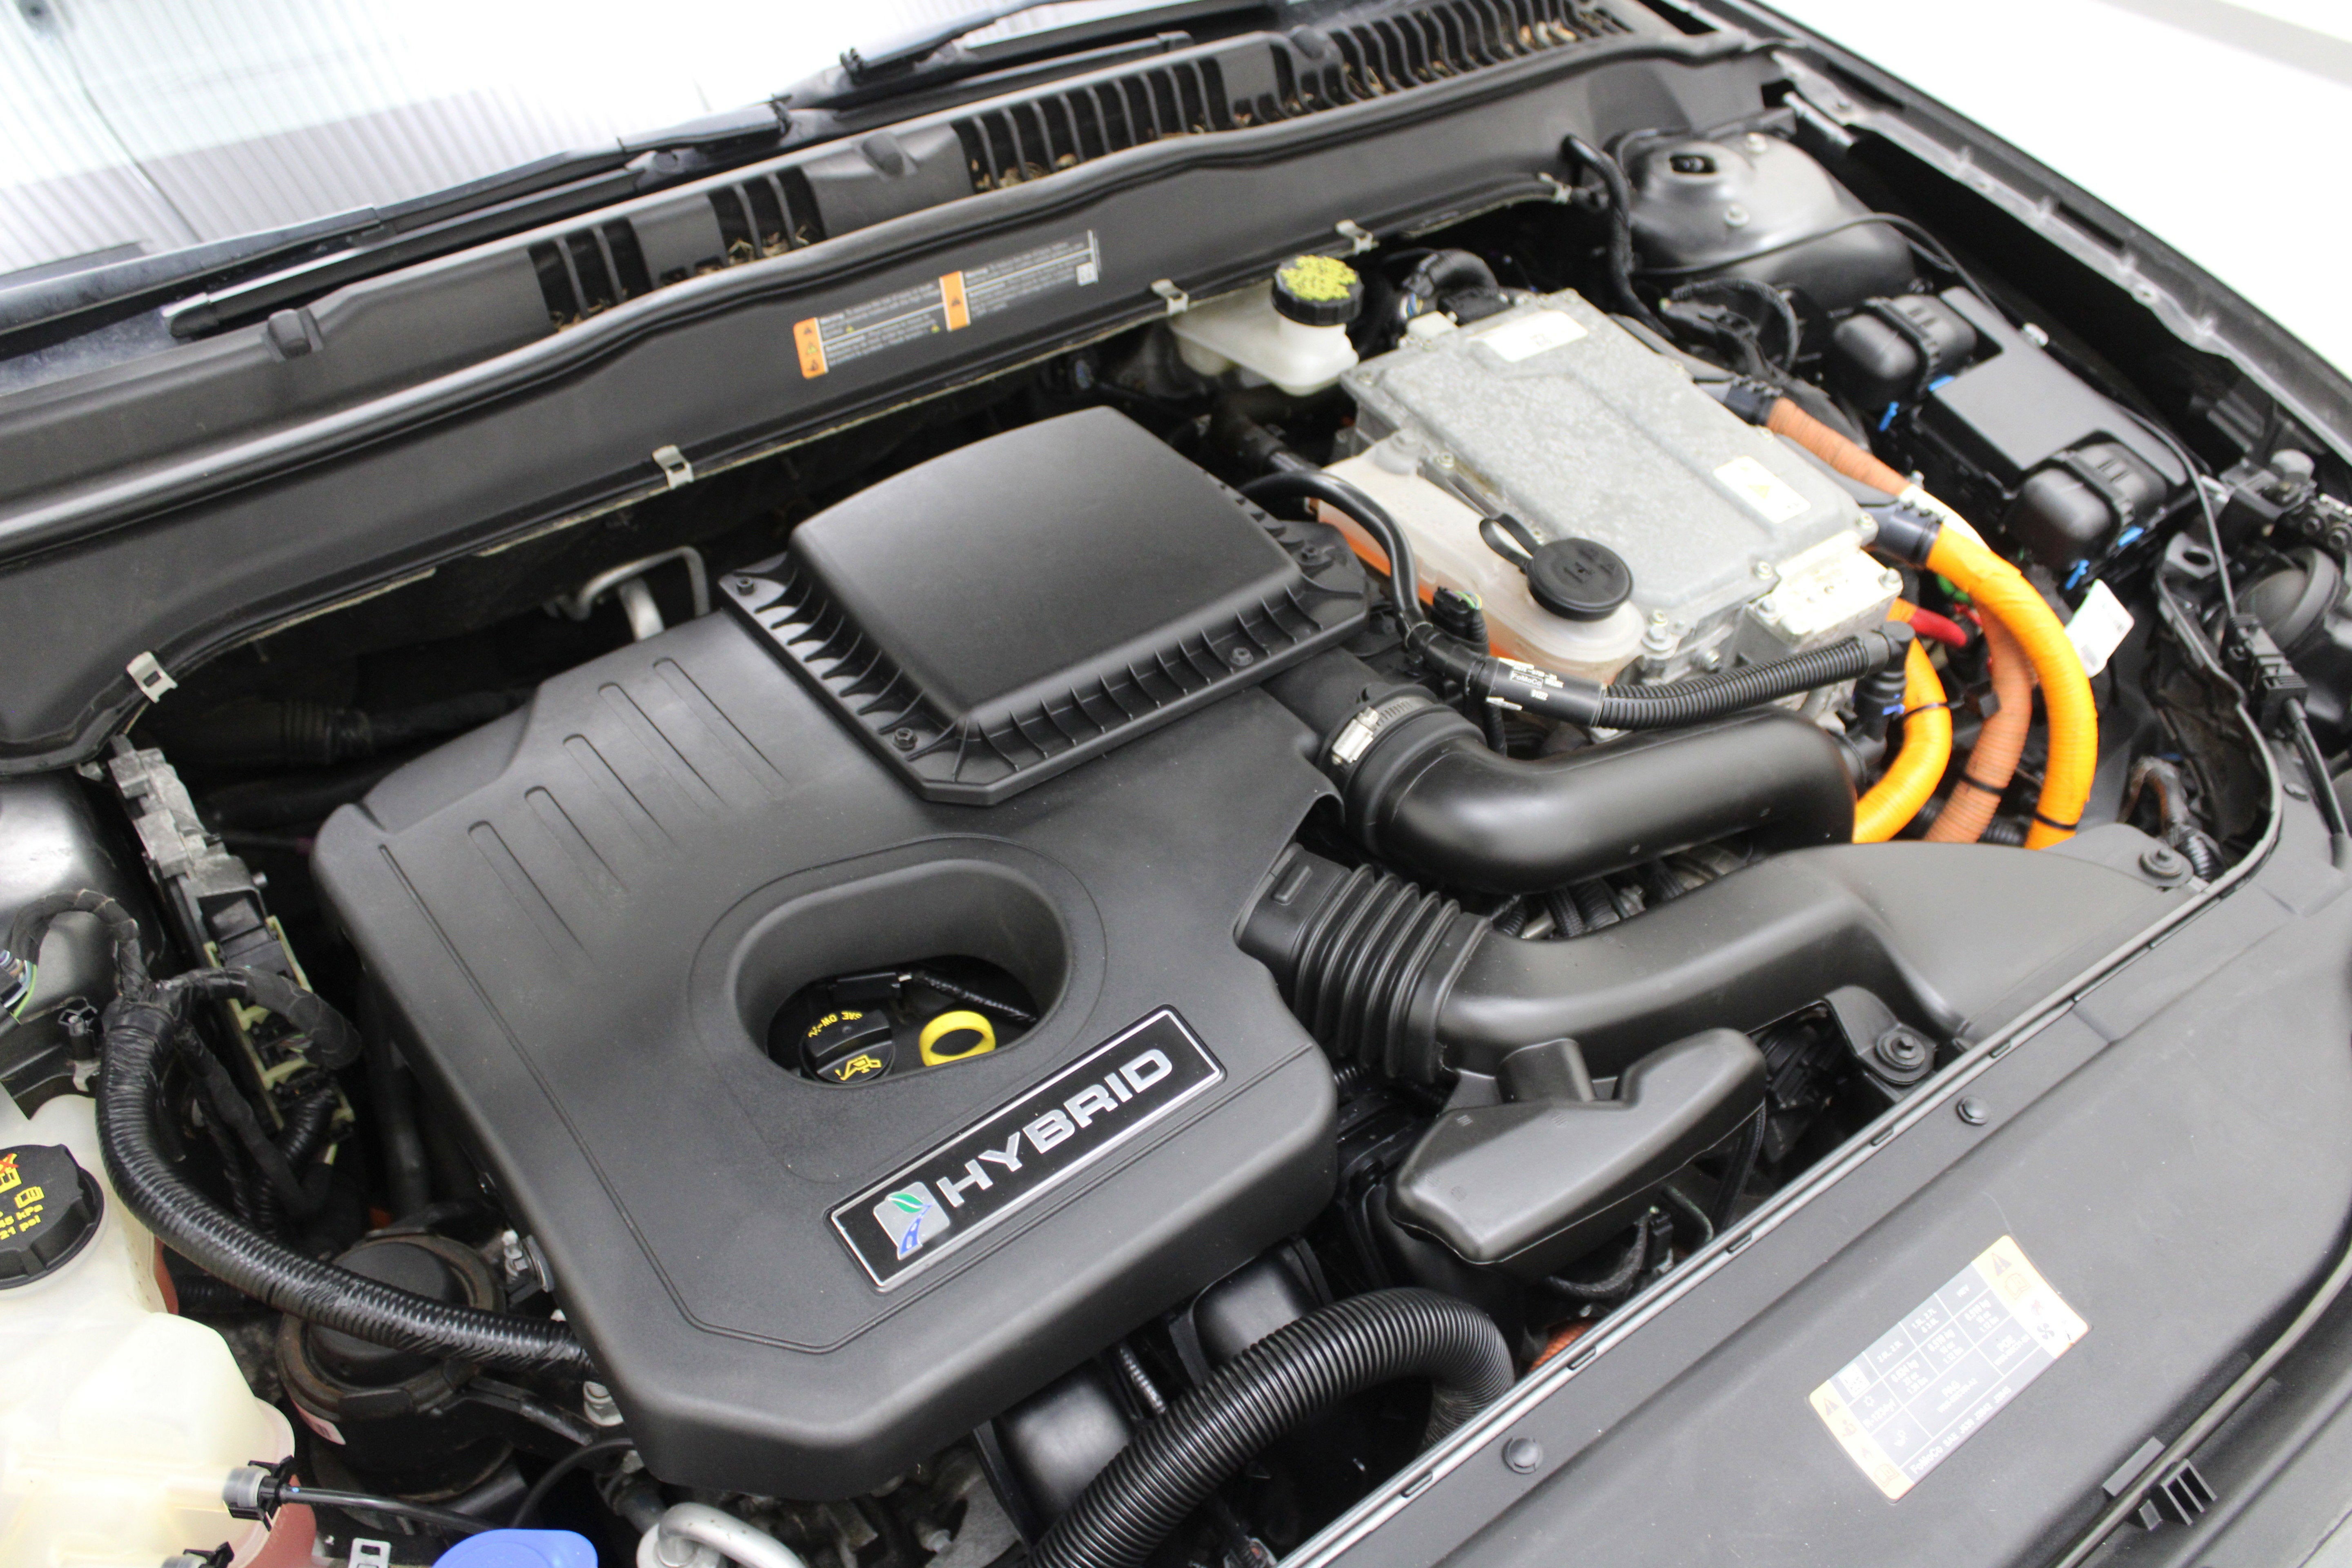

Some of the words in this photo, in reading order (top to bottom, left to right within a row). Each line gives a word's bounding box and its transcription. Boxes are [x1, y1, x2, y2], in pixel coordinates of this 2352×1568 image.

[1512, 672, 1541, 686] FoMoCo
[841, 1011, 863, 1020] SAE
[936, 1048, 1172, 1208] HYBRID
[16, 1204, 44, 1221] kPa
[19, 1214, 41, 1232] psi
[1996, 1334, 2016, 1352] POE
[1941, 1380, 1960, 1398] PAG
[1909, 1446, 1943, 1474] FoMoCo
[1942, 1431, 1960, 1447] SAE
